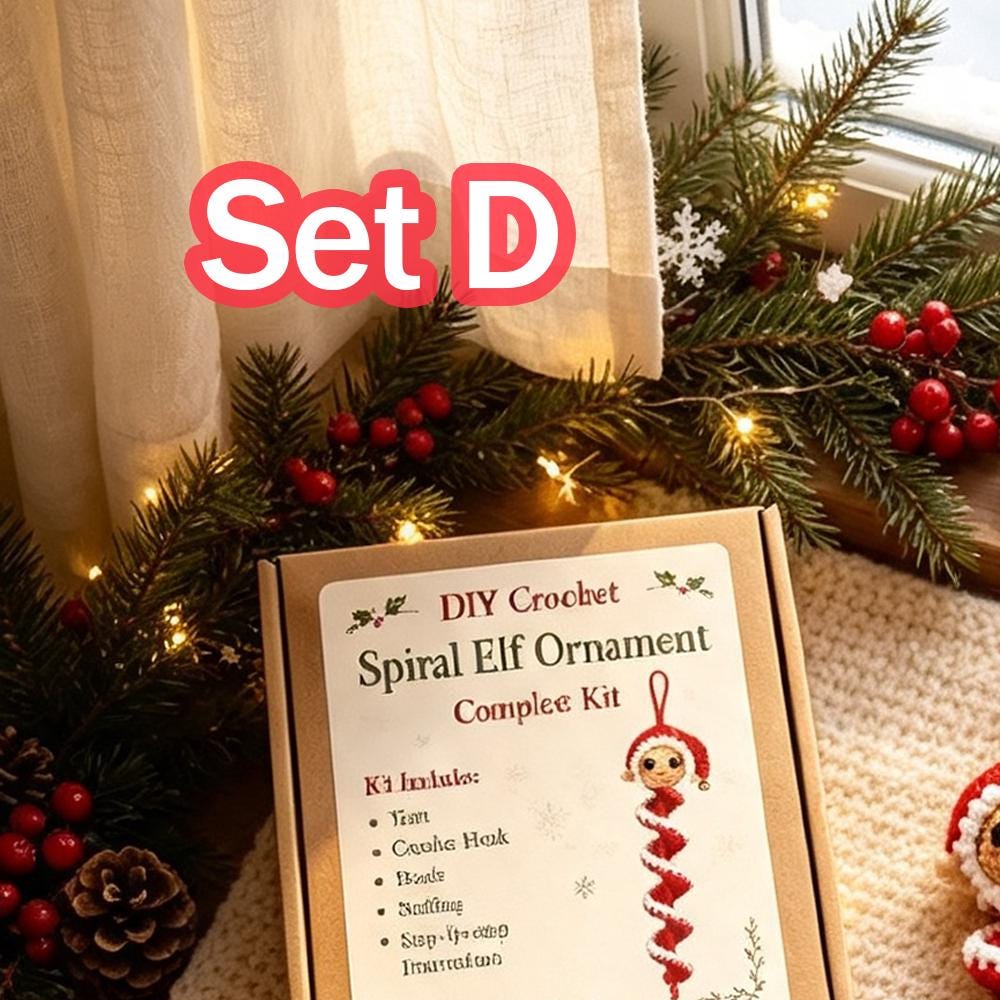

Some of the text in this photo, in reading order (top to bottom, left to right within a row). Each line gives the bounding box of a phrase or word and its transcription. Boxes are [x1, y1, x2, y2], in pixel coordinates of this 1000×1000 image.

[439, 588, 498, 622] DIY
[358, 625, 711, 695] Spiral Elf Ornament
[580, 684, 621, 711] Kit
